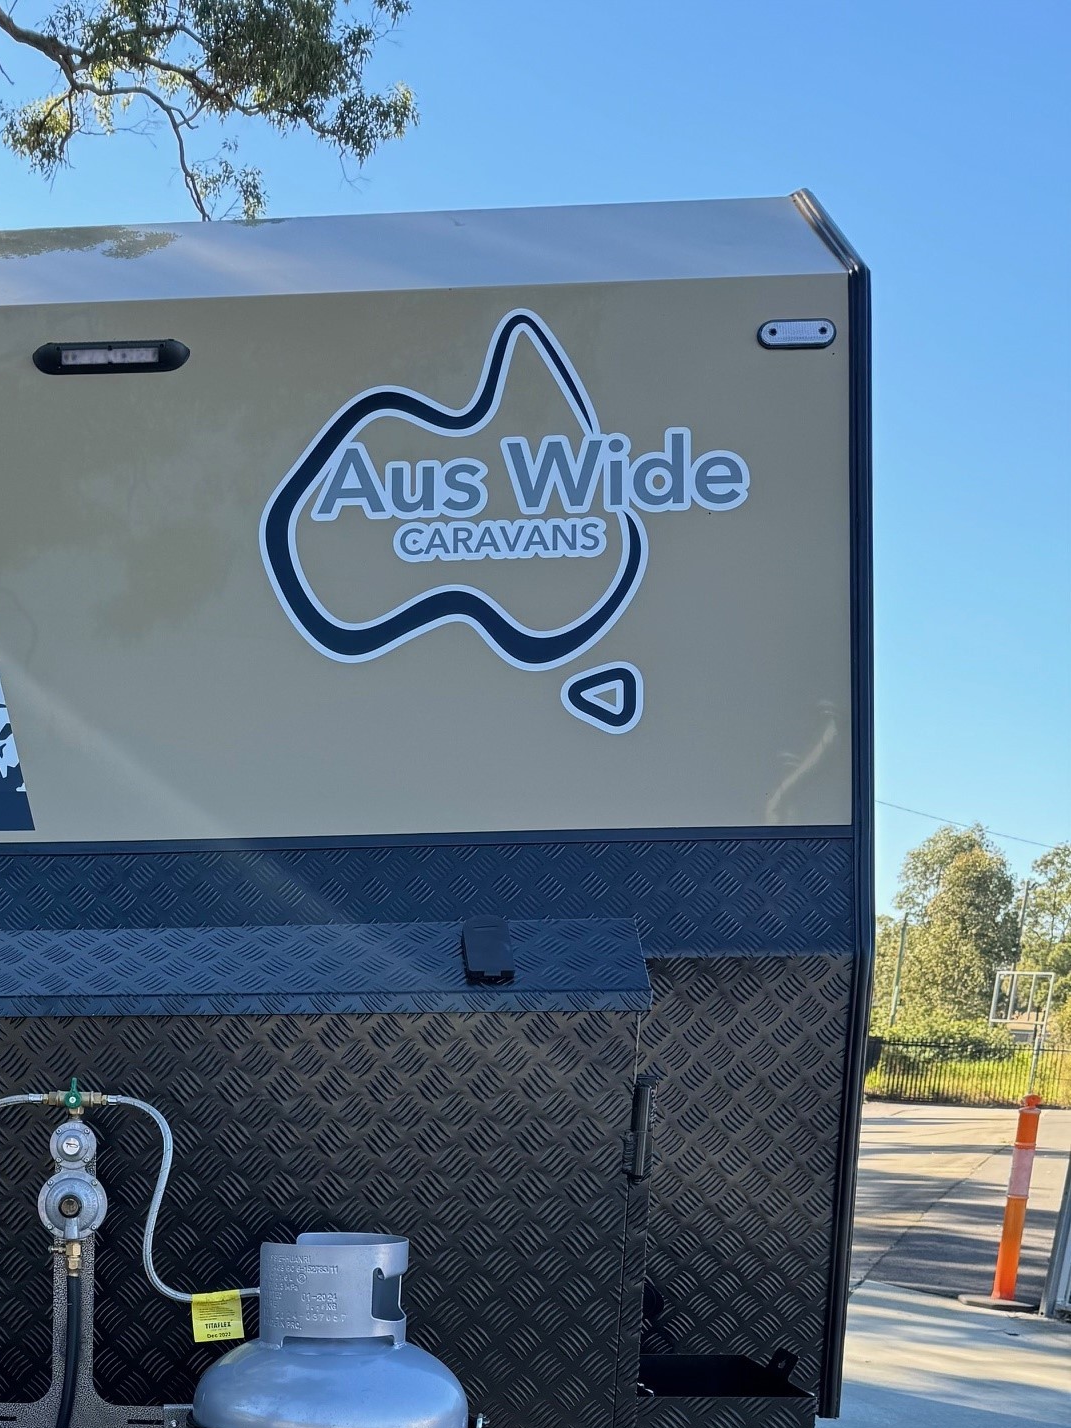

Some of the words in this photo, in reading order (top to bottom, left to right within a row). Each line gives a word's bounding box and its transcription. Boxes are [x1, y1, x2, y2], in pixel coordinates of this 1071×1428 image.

[314, 444, 485, 518] Aus
[503, 430, 747, 511] Wide
[397, 520, 603, 560] CARAVANS
